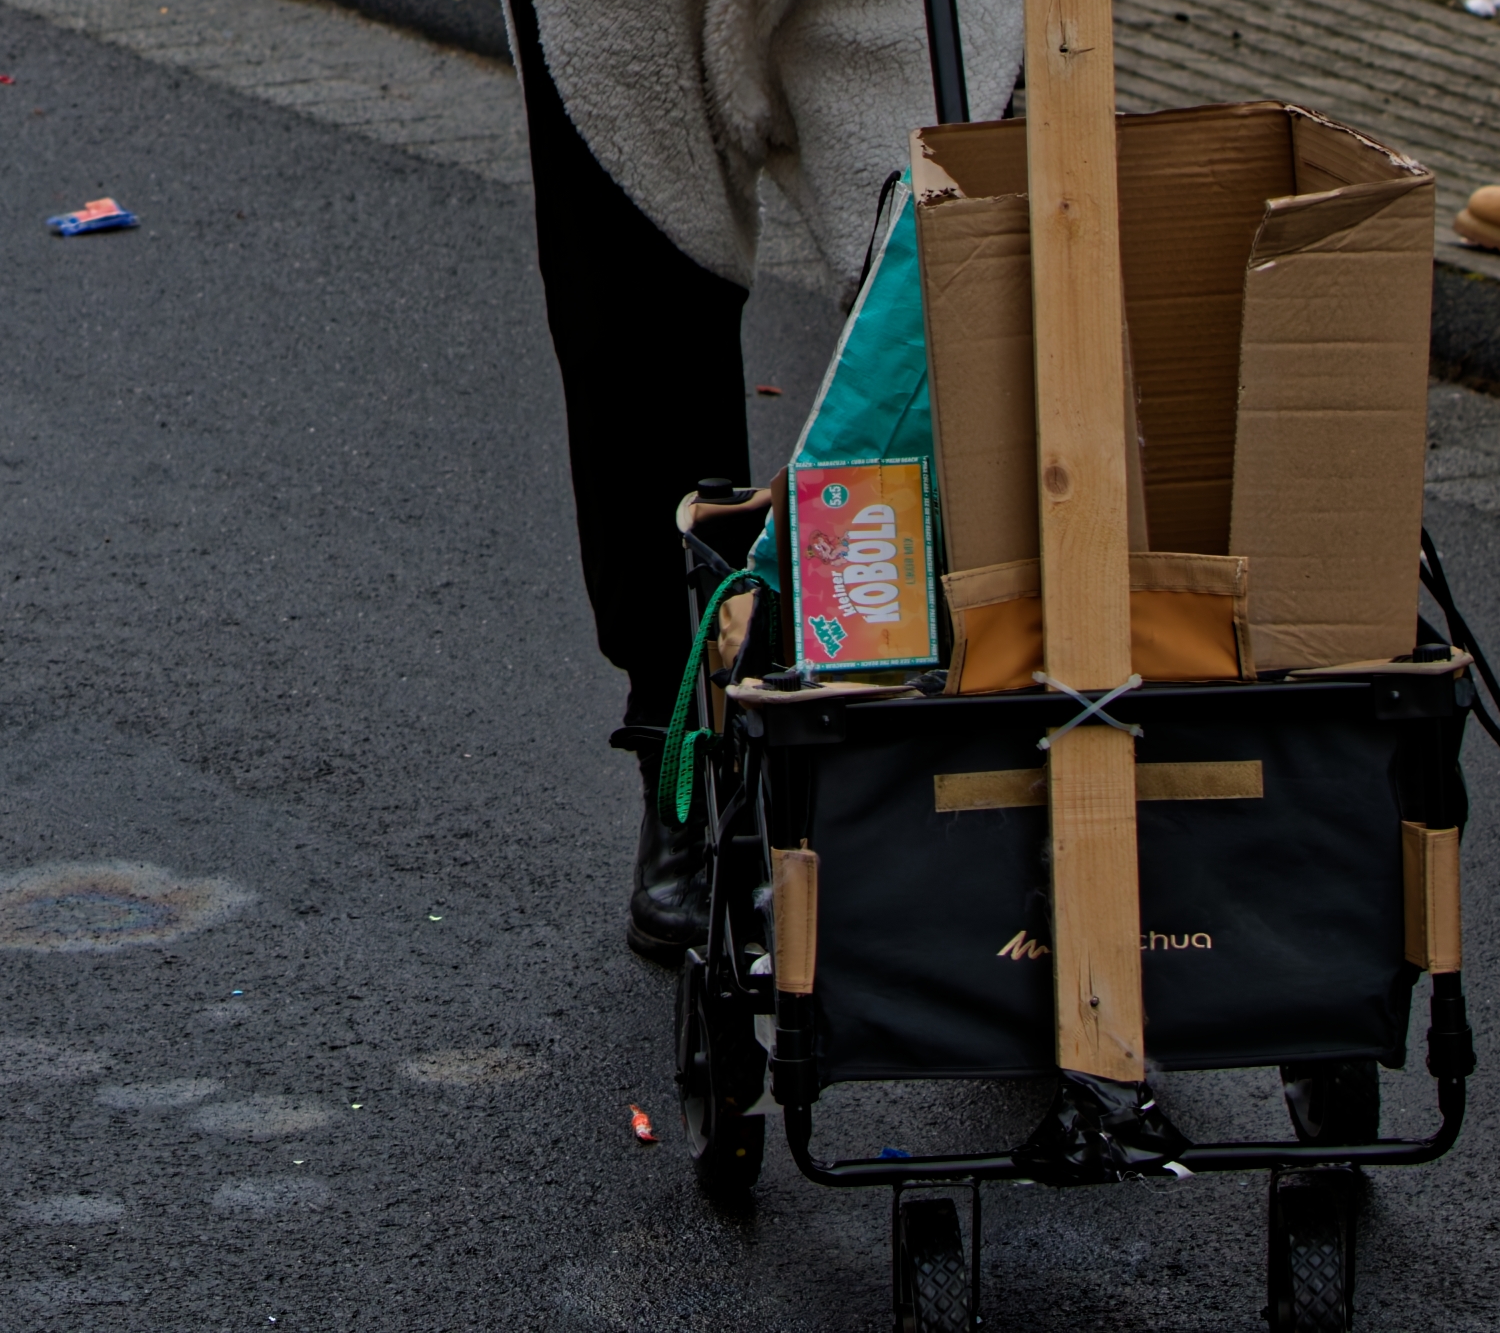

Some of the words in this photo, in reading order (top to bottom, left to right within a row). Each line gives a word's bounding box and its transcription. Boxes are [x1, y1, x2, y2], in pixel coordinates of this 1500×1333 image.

[829, 485, 842, 507] 5x5
[843, 504, 901, 623] KOBOLD
[831, 571, 858, 617] kleiner
